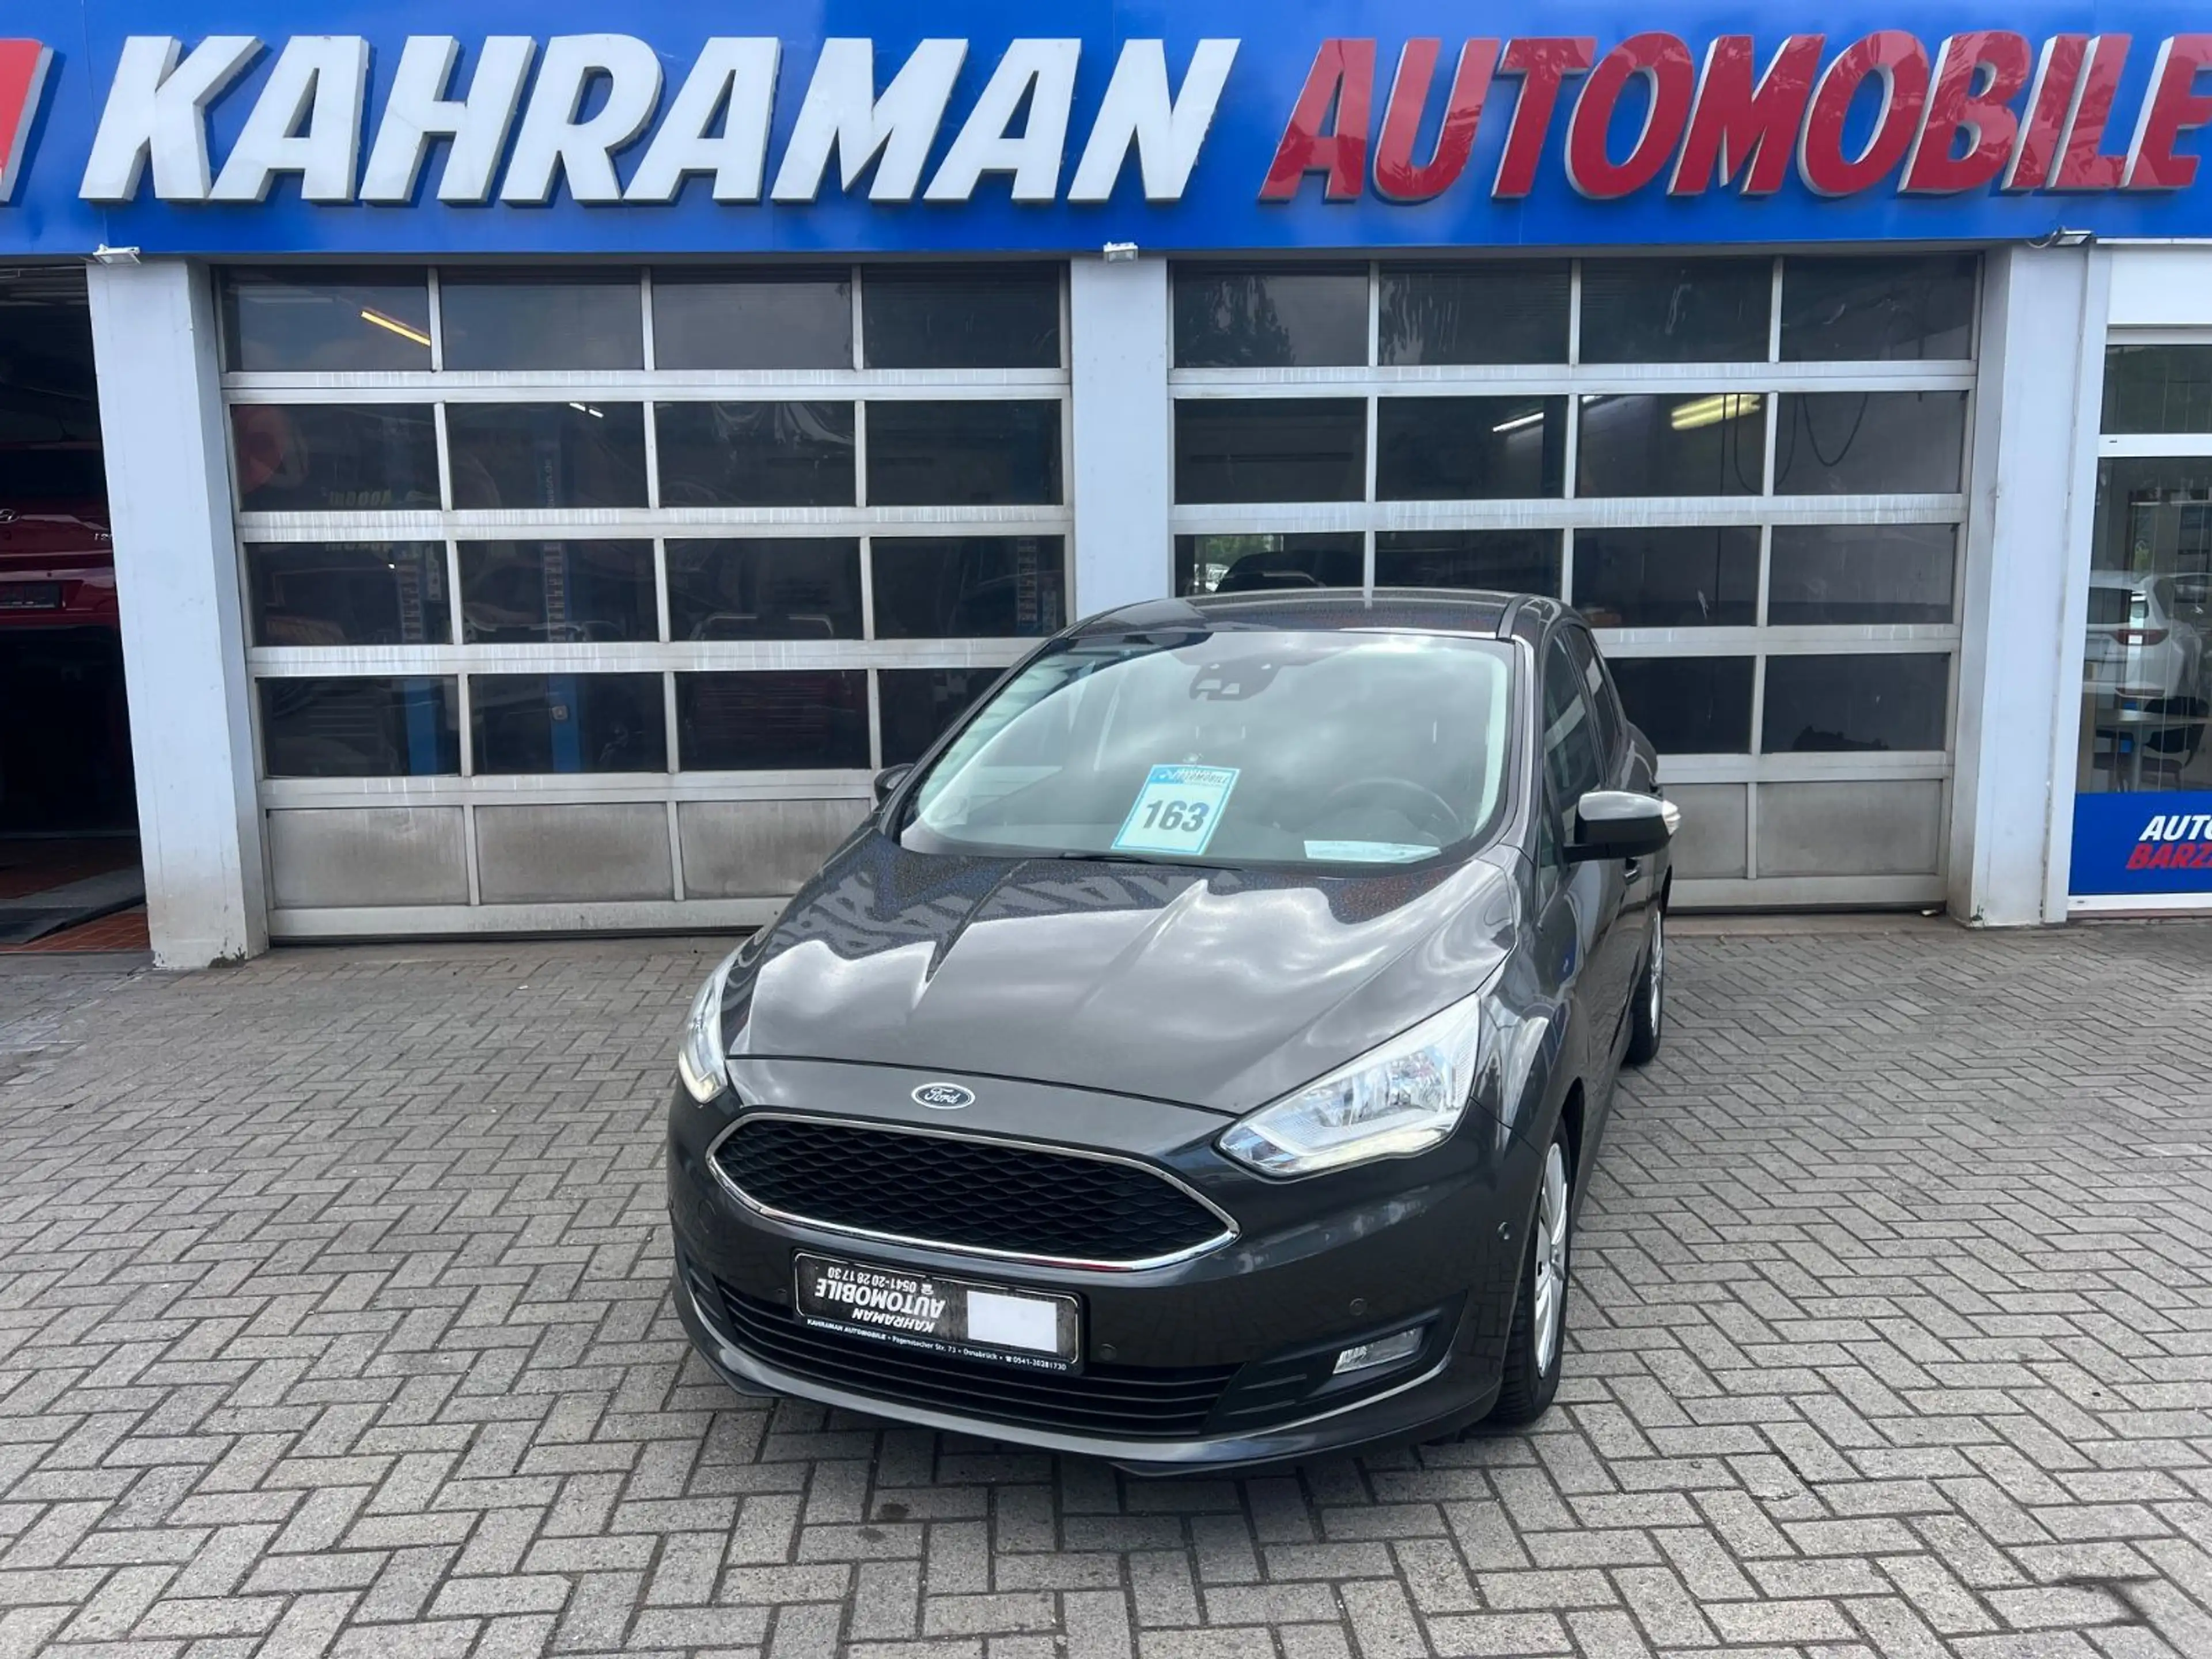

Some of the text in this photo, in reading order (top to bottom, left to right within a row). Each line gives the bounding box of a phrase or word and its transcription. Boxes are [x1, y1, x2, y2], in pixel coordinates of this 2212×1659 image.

[79, 29, 2212, 204] KAHRAMAN AUTOMOBILE
[1143, 800, 1210, 832] 163
[924, 1086, 961, 1104] Ford
[815, 1278, 946, 1319] AUTOMOBILE
[807, 1318, 843, 1332] KAHRAMAN
[844, 1326, 886, 1340] AUTOMOBILE
[963, 1347, 998, 1360] Osnabrück
[851, 1308, 935, 1334] KAHRAMAN
